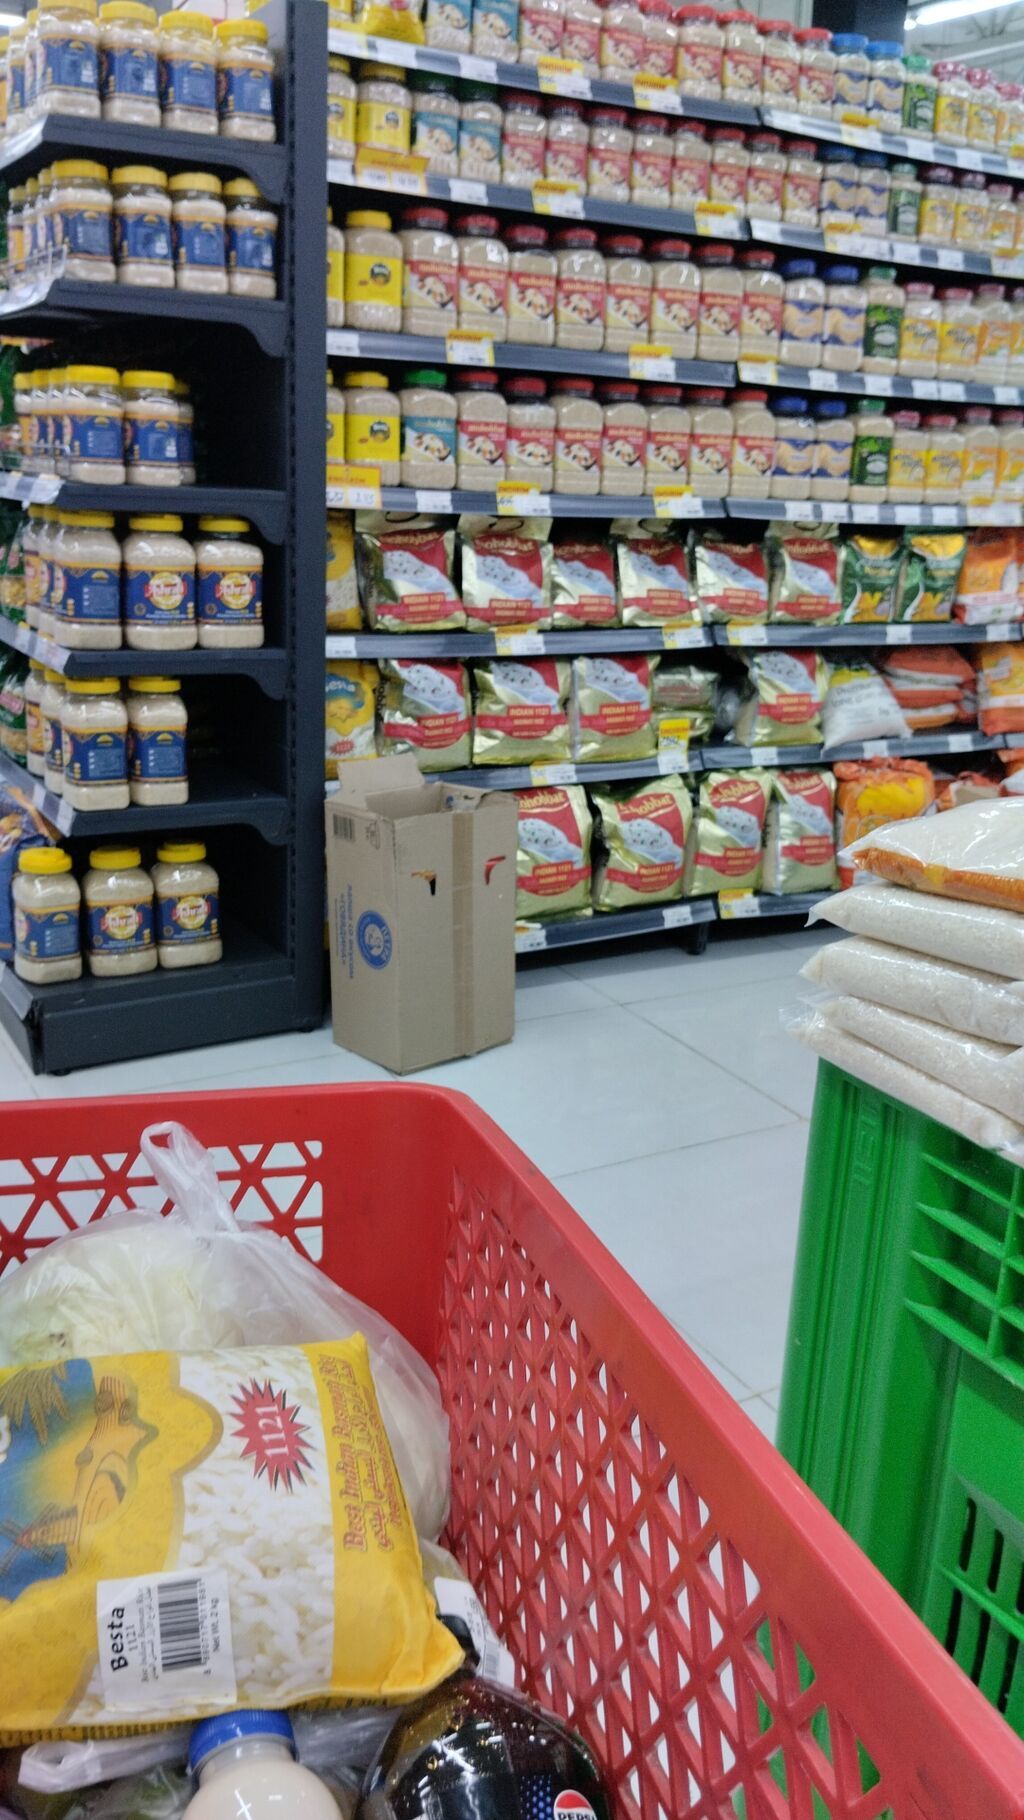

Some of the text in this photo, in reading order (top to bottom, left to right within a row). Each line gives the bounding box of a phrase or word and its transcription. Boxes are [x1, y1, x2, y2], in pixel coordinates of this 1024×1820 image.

[254, 1403, 290, 1458] 1121
[336, 1443, 359, 1499] Indian
[343, 1504, 363, 1550] Best
[209, 1597, 219, 1610] kg
[107, 1606, 129, 1673] Besta
[126, 1623, 139, 1652] 1121
